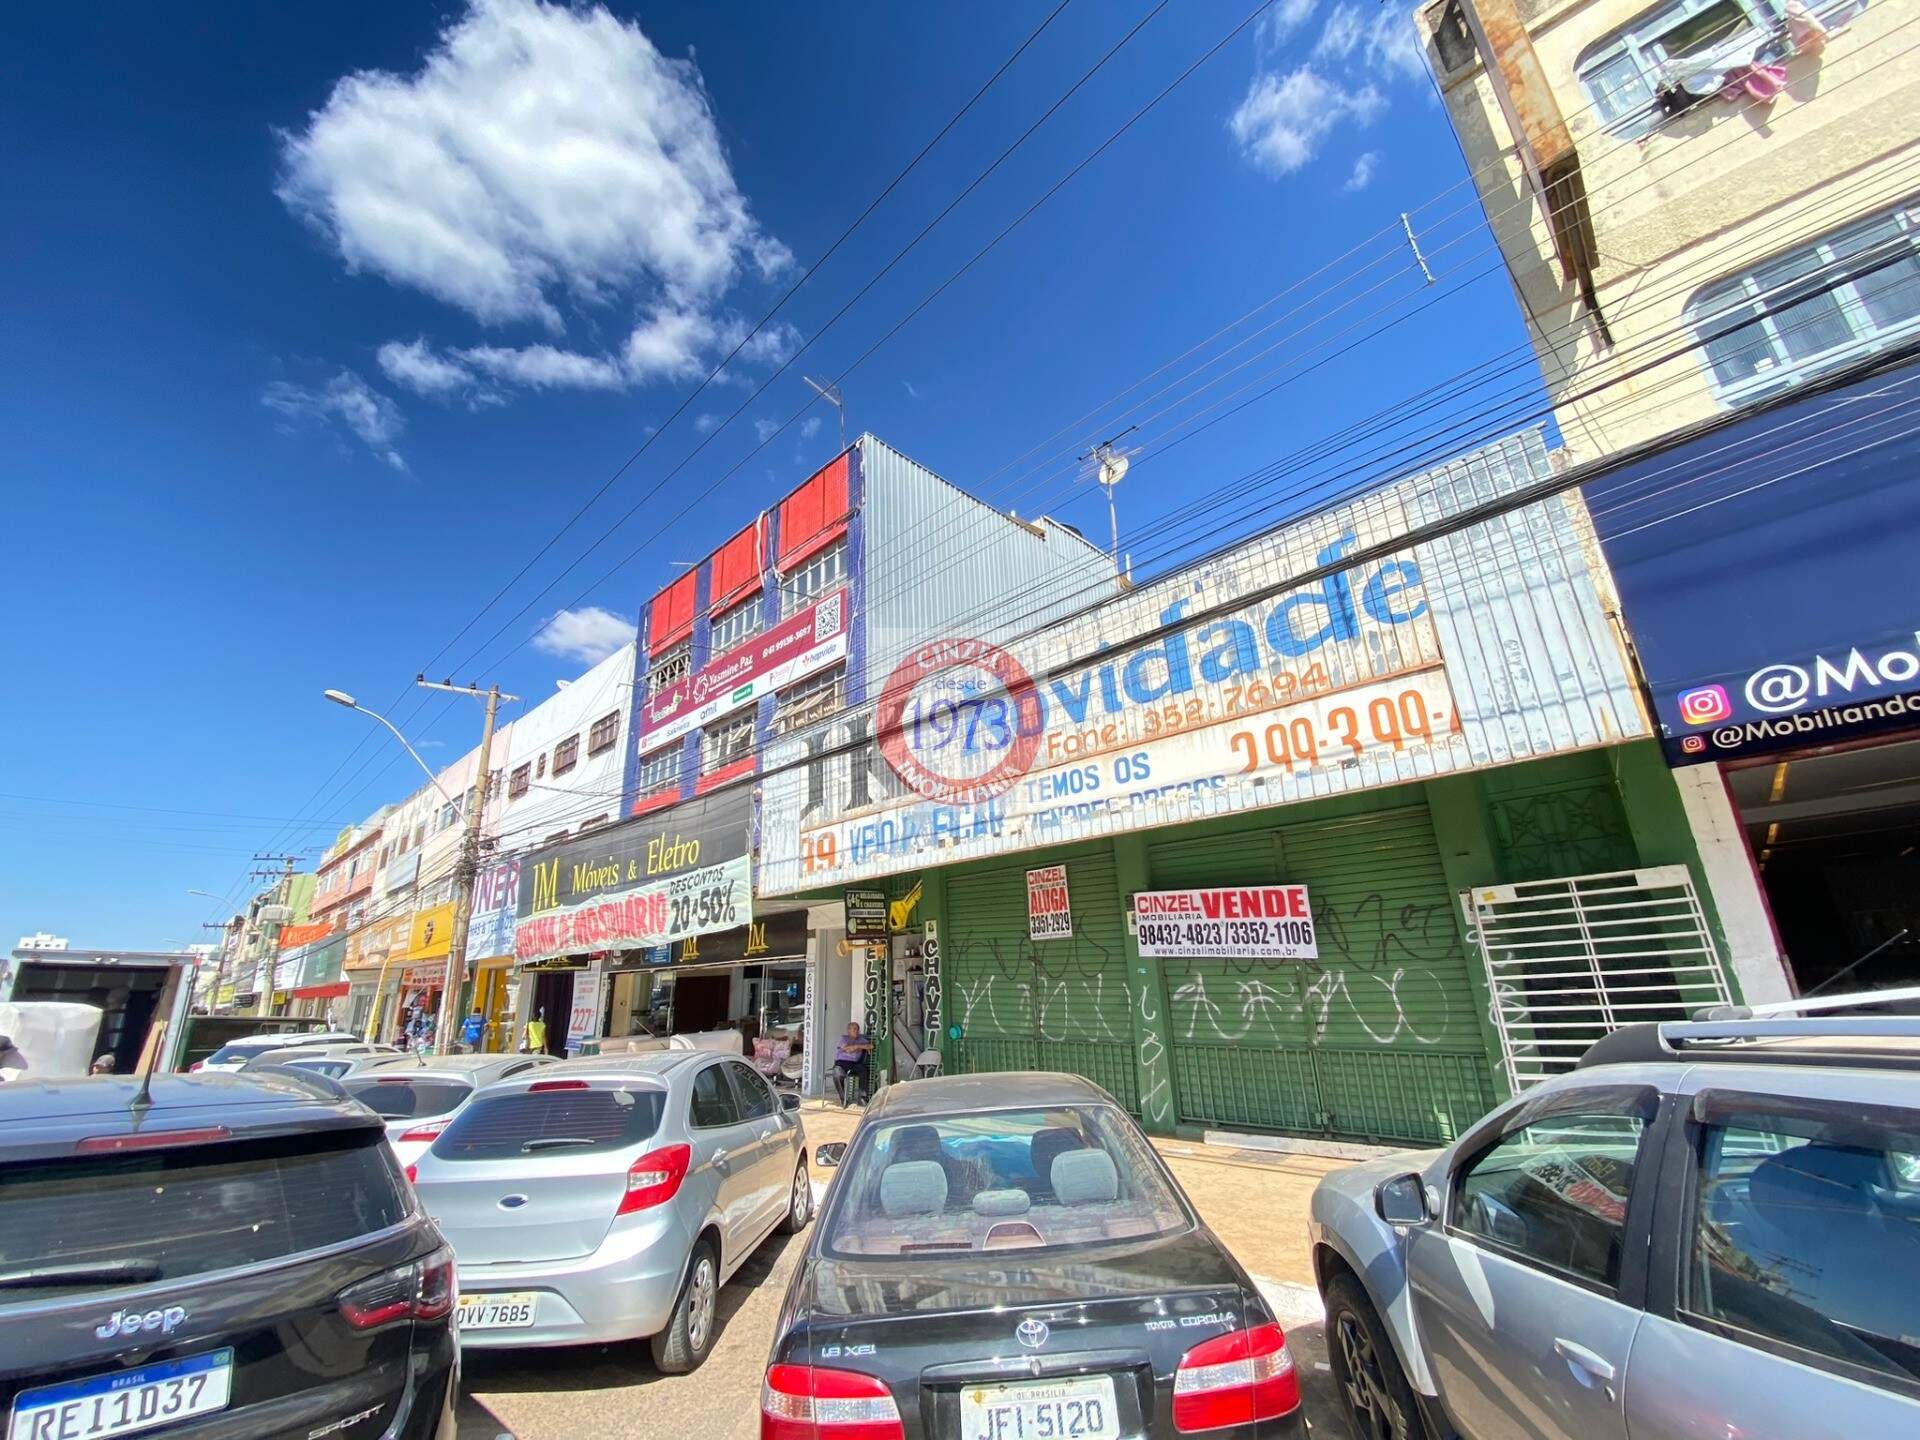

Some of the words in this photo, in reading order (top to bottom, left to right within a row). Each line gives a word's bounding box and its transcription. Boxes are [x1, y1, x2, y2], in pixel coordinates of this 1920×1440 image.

[709, 663, 740, 685] Yasmine
[740, 655, 753, 669] Paz
[1745, 631, 1920, 713] @Mo
[1025, 765, 1100, 804] TEMOS
[1113, 752, 1151, 785] OS
[571, 856, 619, 896] Móveis
[627, 859, 637, 880] &
[646, 832, 700, 876] Eletro
[1028, 868, 1065, 886] CINZEL
[670, 866, 725, 895] DESCONTOS
[670, 895, 691, 934] 20
[691, 899, 699, 918] A
[698, 879, 736, 928] 50%
[1030, 886, 1068, 914] ALUGA
[1136, 894, 1200, 914] CINZEL
[1200, 888, 1308, 919] VENDE
[1030, 912, 1070, 934] 3351-2929
[1138, 913, 1203, 922] IMOBILIARIA
[743, 923, 769, 957] JM
[1153, 946, 1298, 957] www.cinzelimobiliaria.com.br
[95, 1305, 186, 1339] Jeep
[490, 1304, 530, 1323] 7685
[1144, 1319, 1177, 1331] TOYOTA
[1180, 1311, 1237, 1327] COROLLA
[110, 1374, 146, 1389] BRASIL
[30, 1373, 208, 1440] REI1D37
[307, 1402, 386, 1440] SPORT
[1037, 1399, 1104, 1437] 5120
